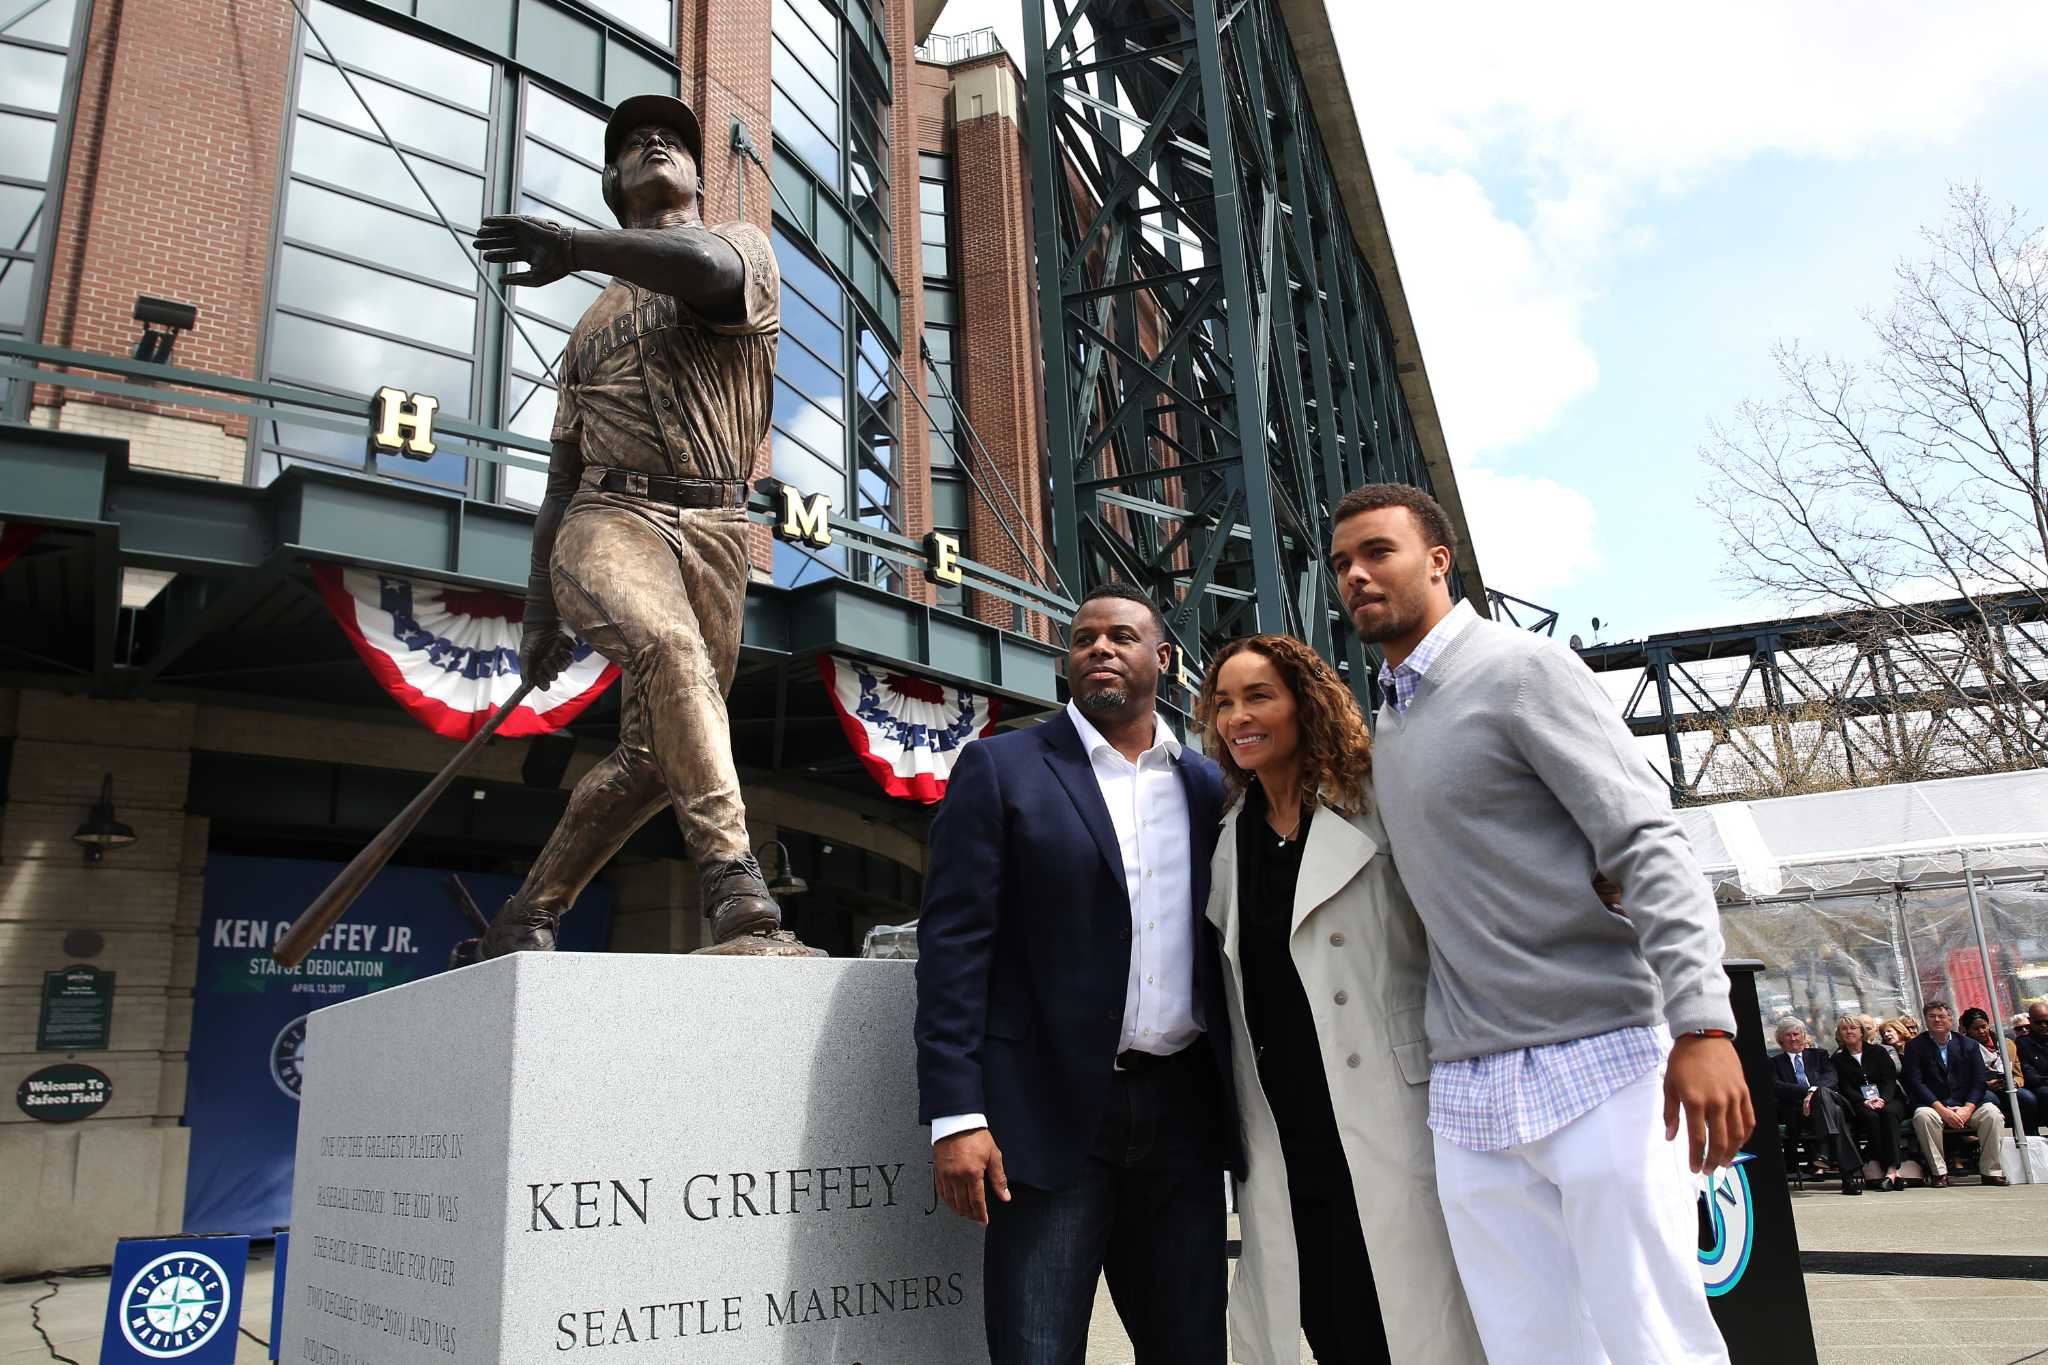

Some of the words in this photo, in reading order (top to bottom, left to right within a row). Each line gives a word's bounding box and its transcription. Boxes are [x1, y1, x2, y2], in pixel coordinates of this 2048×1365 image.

[213, 918, 268, 948] KEN
[274, 921, 377, 952] GFFEY
[381, 926, 419, 953] JR.
[306, 959, 383, 977] DEDICATION
[292, 984, 315, 993] APRIL
[329, 984, 346, 994] 2017
[26, 1094, 69, 1106] Safeco
[71, 1092, 104, 1104] Field
[28, 1080, 86, 1093] Welcome
[87, 1079, 104, 1090] To
[408, 1134, 447, 1159] PLAYERS
[451, 1134, 464, 1159] IN
[437, 1195, 459, 1223] WAS
[525, 1178, 653, 1233] KEN
[683, 1163, 905, 1221] GRIFFEY
[137, 1261, 219, 1296] SEATTLE
[361, 1244, 377, 1269] THE
[380, 1248, 405, 1275] GAME
[408, 1253, 426, 1281] FOR
[429, 1256, 455, 1287] OVER
[556, 1296, 743, 1351] SEATTLE
[765, 1272, 965, 1327] MARINERS
[132, 1311, 217, 1348] MARINERS
[408, 1316, 431, 1345] AND
[434, 1322, 456, 1354] WAS
